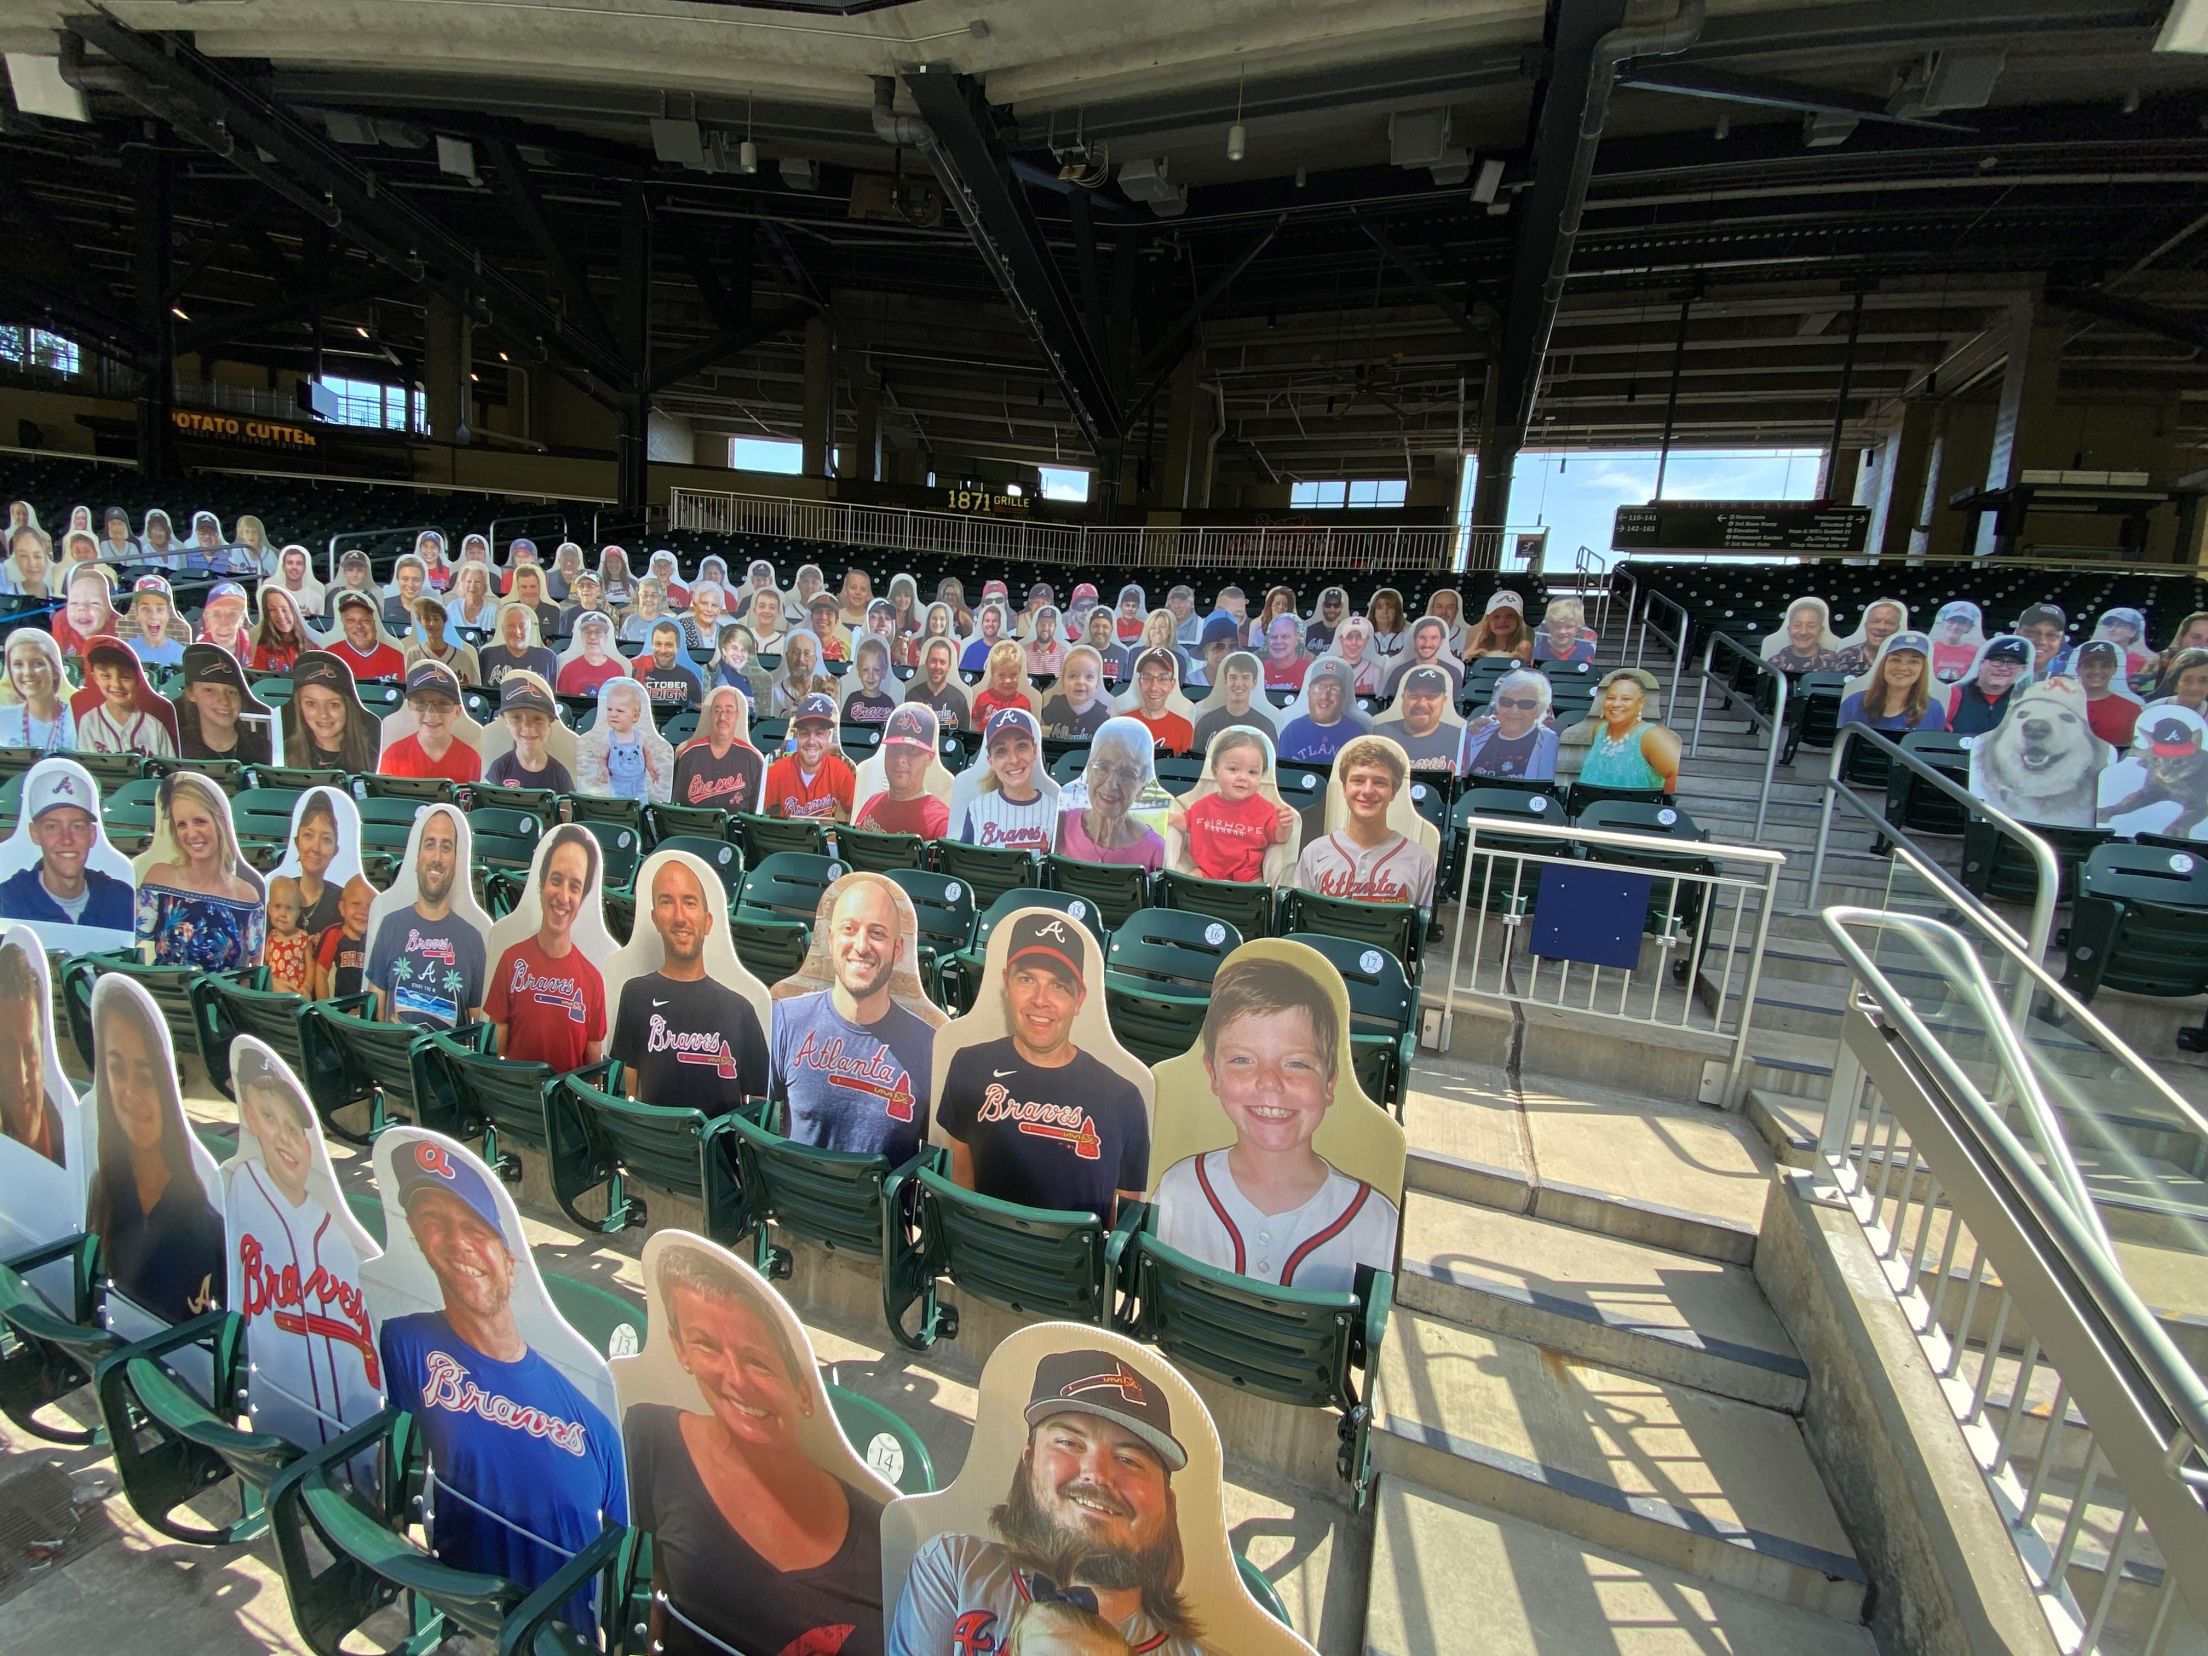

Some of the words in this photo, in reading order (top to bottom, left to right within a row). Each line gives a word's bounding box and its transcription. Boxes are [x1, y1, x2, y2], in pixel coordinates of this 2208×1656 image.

[171, 412, 240, 435] OTATO
[948, 490, 991, 511] 1871
[993, 495, 1030, 508] GRILLE
[645, 681, 688, 689] CTOBER
[650, 688, 688, 700] EIGN
[808, 699, 823, 712] A
[996, 709, 1018, 728] A
[52, 775, 75, 796] A
[688, 772, 745, 803] Braves
[980, 821, 1041, 848] Braves
[1196, 816, 1263, 836] FAIRHOPE
[1319, 868, 1397, 898] Atlanta
[1072, 906, 1081, 915] 15
[405, 928, 449, 951] Braves
[1035, 919, 1065, 944] A
[1209, 928, 1220, 939] 16
[417, 960, 434, 983] A
[1365, 957, 1377, 968] 17
[511, 958, 574, 994] Braves
[648, 1013, 720, 1053] Braves
[793, 1028, 895, 1083] Atlanta
[978, 1083, 1084, 1129] Braves
[239, 1232, 367, 1328] Braves
[187, 1272, 213, 1314] A
[616, 1336, 630, 1354] 13
[421, 1350, 588, 1457] Braves
[876, 1448, 893, 1472] 14
